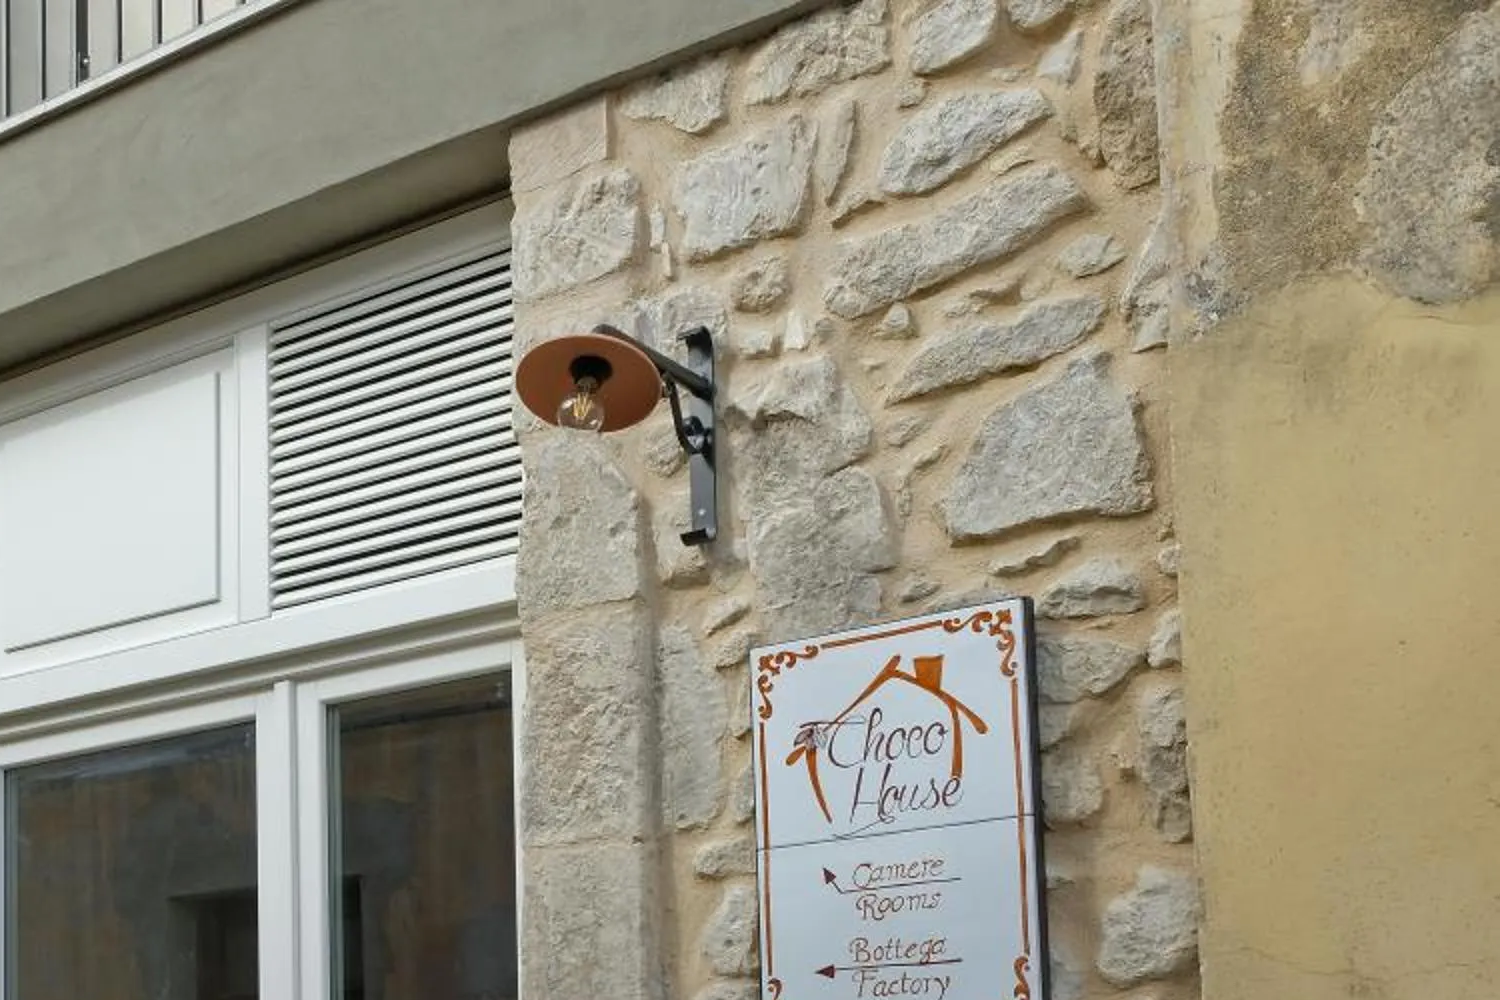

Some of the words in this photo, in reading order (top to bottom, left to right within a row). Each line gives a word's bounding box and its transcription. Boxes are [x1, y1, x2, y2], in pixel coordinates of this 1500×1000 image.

[825, 706, 949, 769] Choco
[849, 762, 964, 825] House
[851, 859, 945, 890] Camere
[855, 892, 942, 921] Rooms
[849, 936, 947, 966] Bottega
